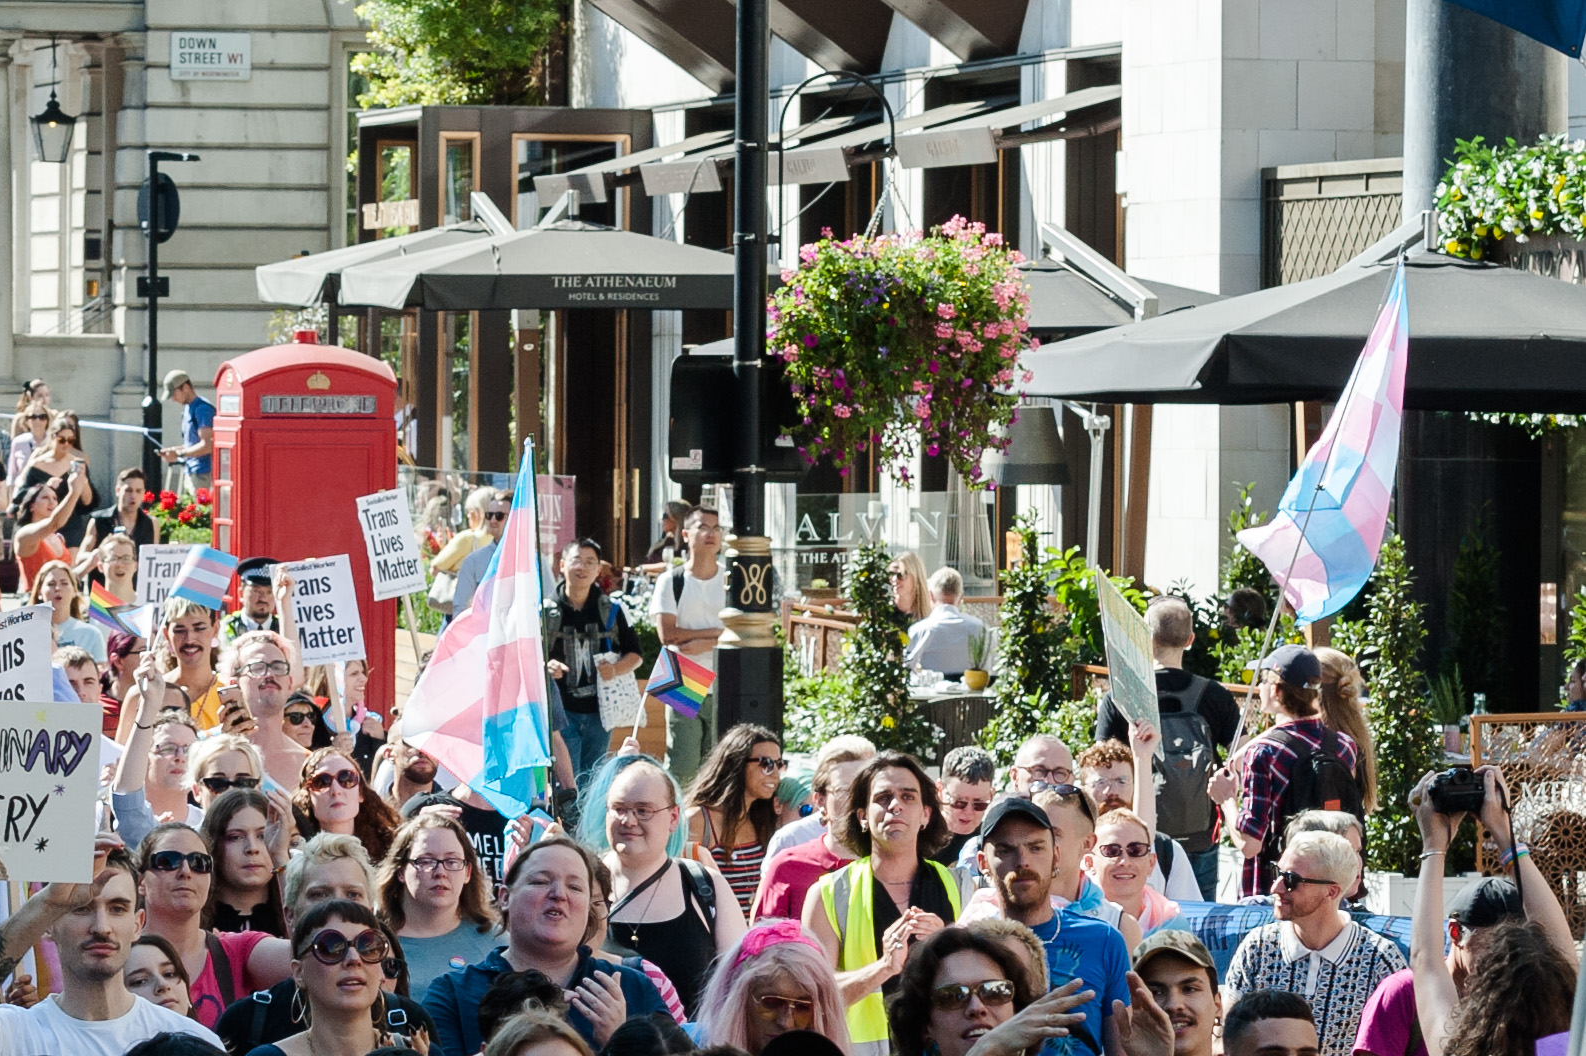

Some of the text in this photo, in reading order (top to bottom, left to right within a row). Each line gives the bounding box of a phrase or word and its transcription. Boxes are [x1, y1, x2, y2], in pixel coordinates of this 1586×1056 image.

[179, 37, 217, 49] DOWN
[179, 52, 243, 64] STREET W1
[551, 276, 677, 288] THE ATHENAEUM
[362, 508, 399, 531] Trans
[371, 533, 404, 557] Lives
[145, 556, 182, 578] Tran
[313, 561, 336, 569] Worker
[802, 552, 828, 564] THE
[376, 556, 419, 583] Matter
[145, 582, 170, 603] Liv
[293, 576, 332, 597] ans
[7, 611, 34, 626] Worker
[295, 601, 335, 624] ives
